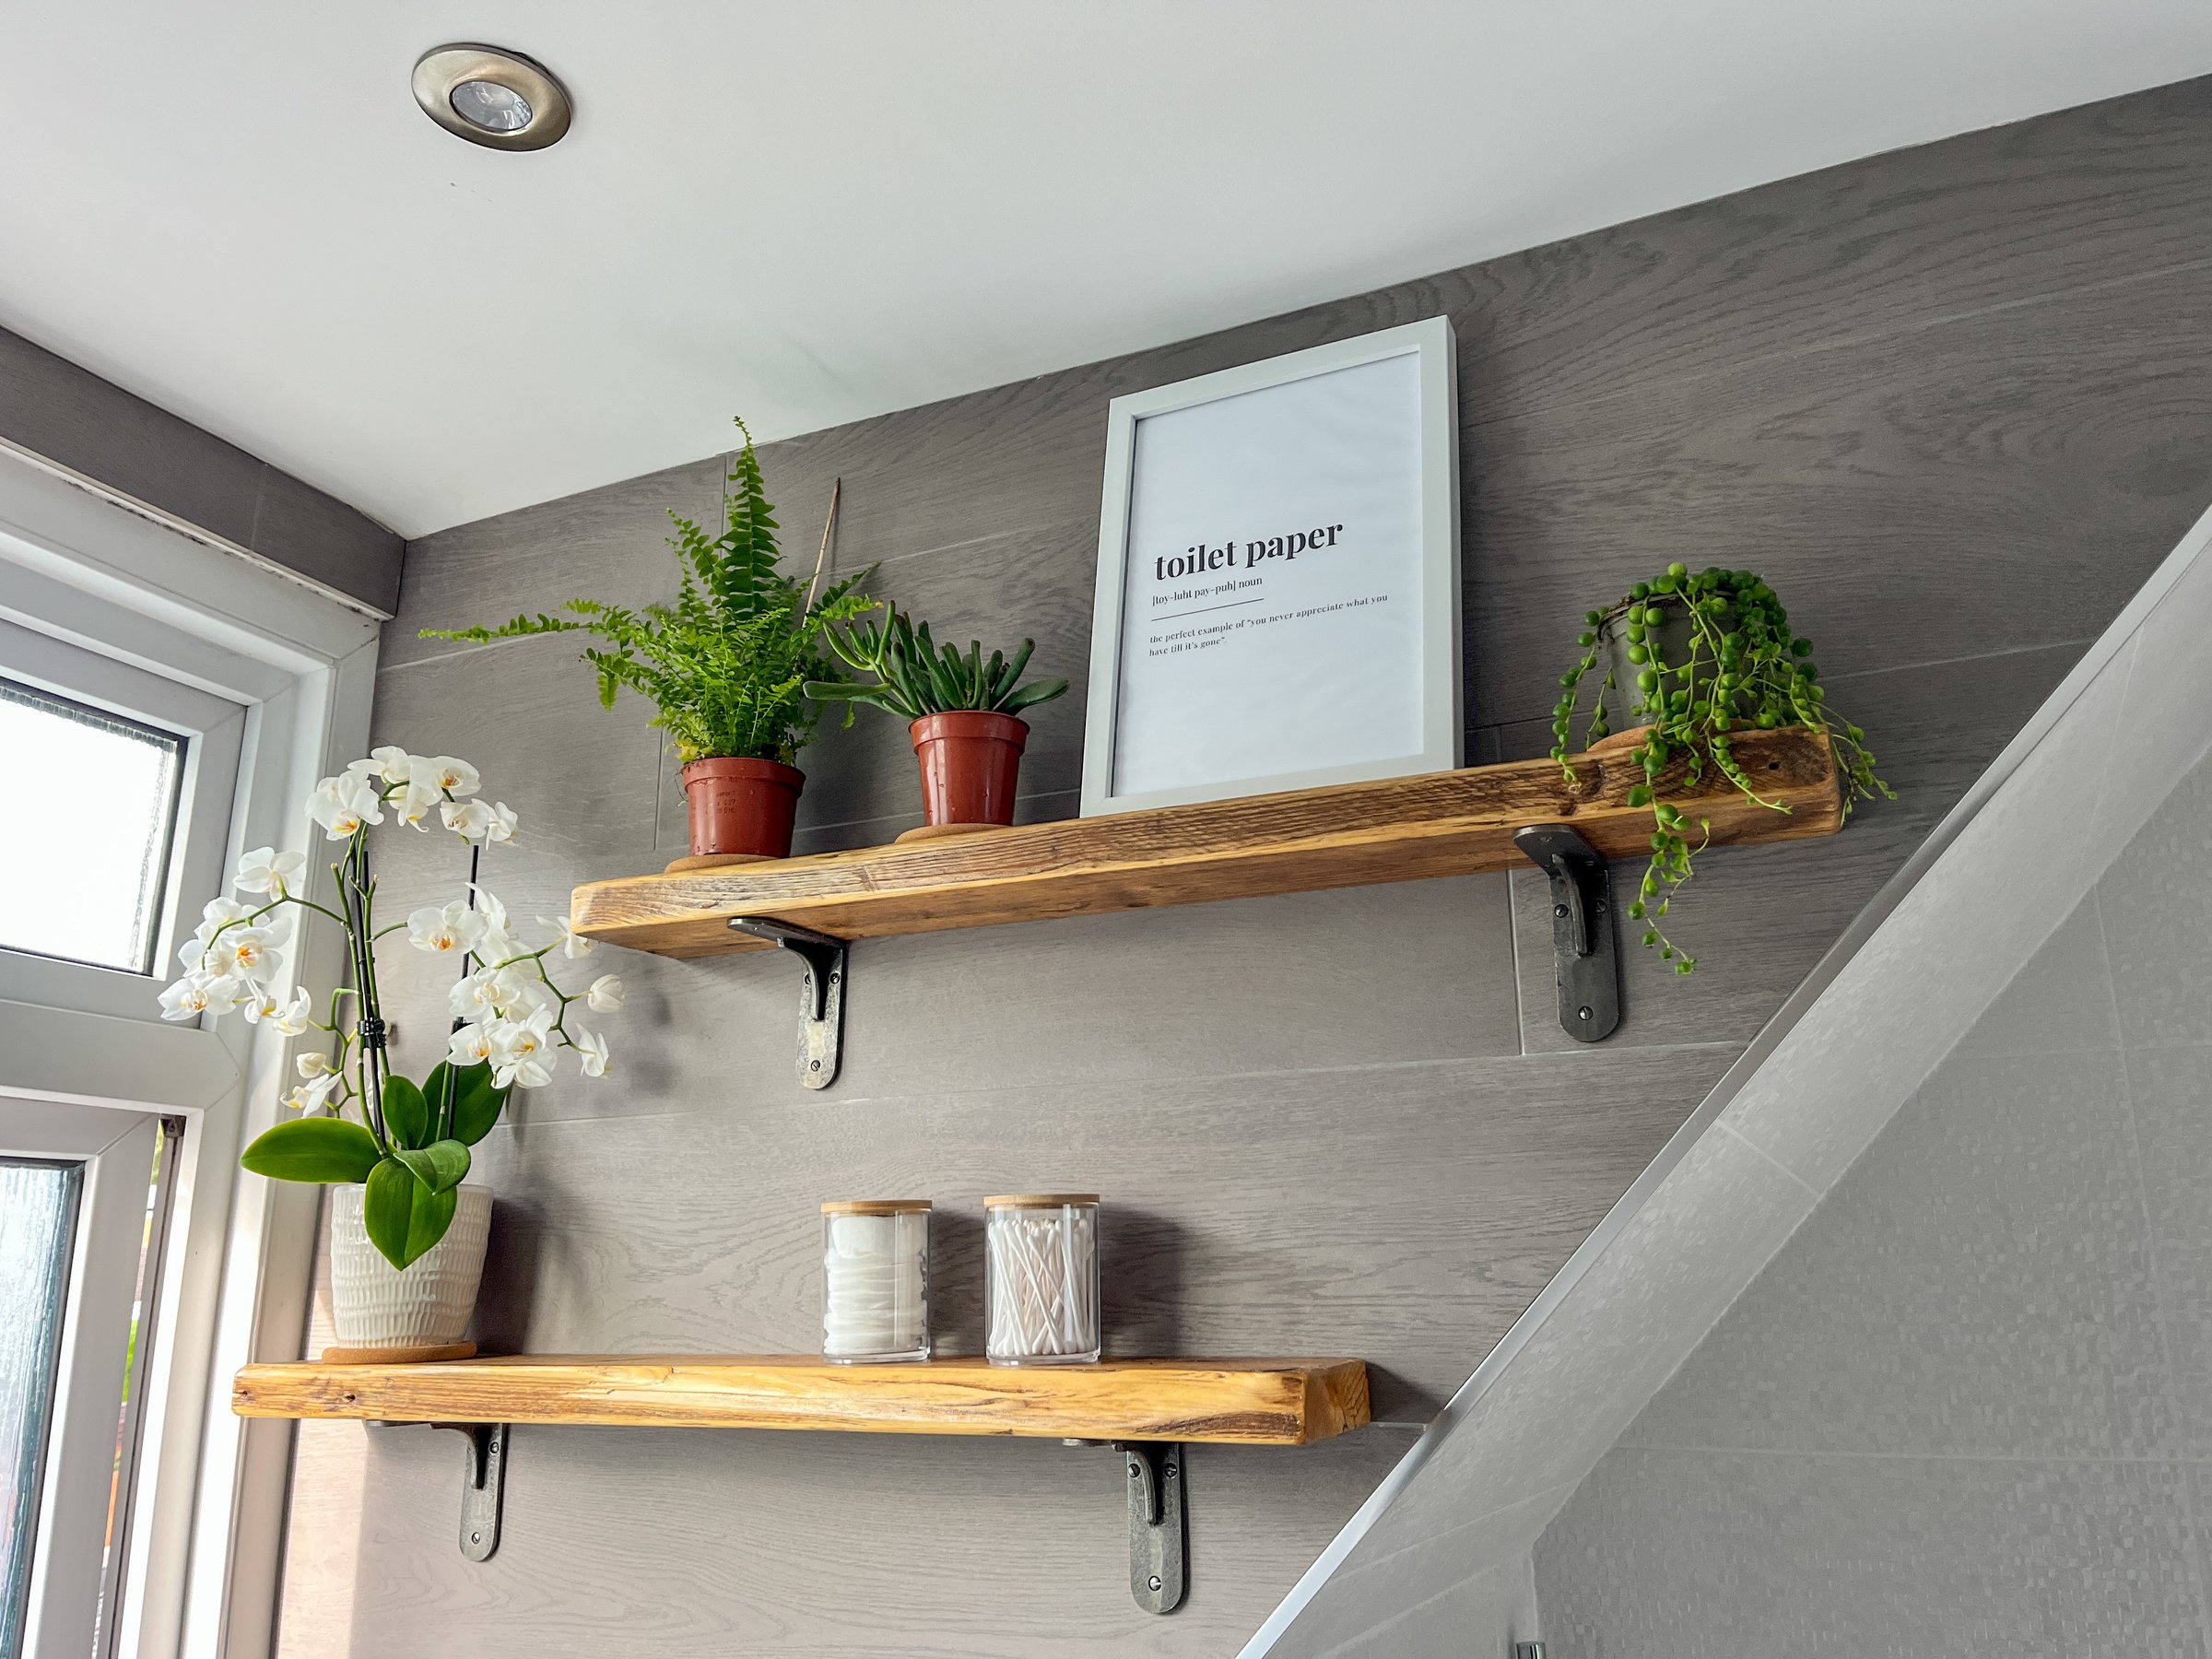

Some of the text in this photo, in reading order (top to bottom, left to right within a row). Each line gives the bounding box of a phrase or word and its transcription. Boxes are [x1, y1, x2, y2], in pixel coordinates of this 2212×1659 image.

[1154, 524, 1343, 581] toilet paper
[1238, 577, 1263, 589] noun
[1149, 635, 1162, 643] the
[1165, 629, 1196, 642] perfect
[1197, 621, 1233, 636] example
[1235, 619, 1245, 629] of
[1269, 612, 1294, 623] never
[1296, 603, 1344, 618] appreciate
[1347, 596, 1370, 608] what
[1371, 594, 1389, 605] you
[1148, 648, 1169, 657] have
[1171, 643, 1183, 653] till
